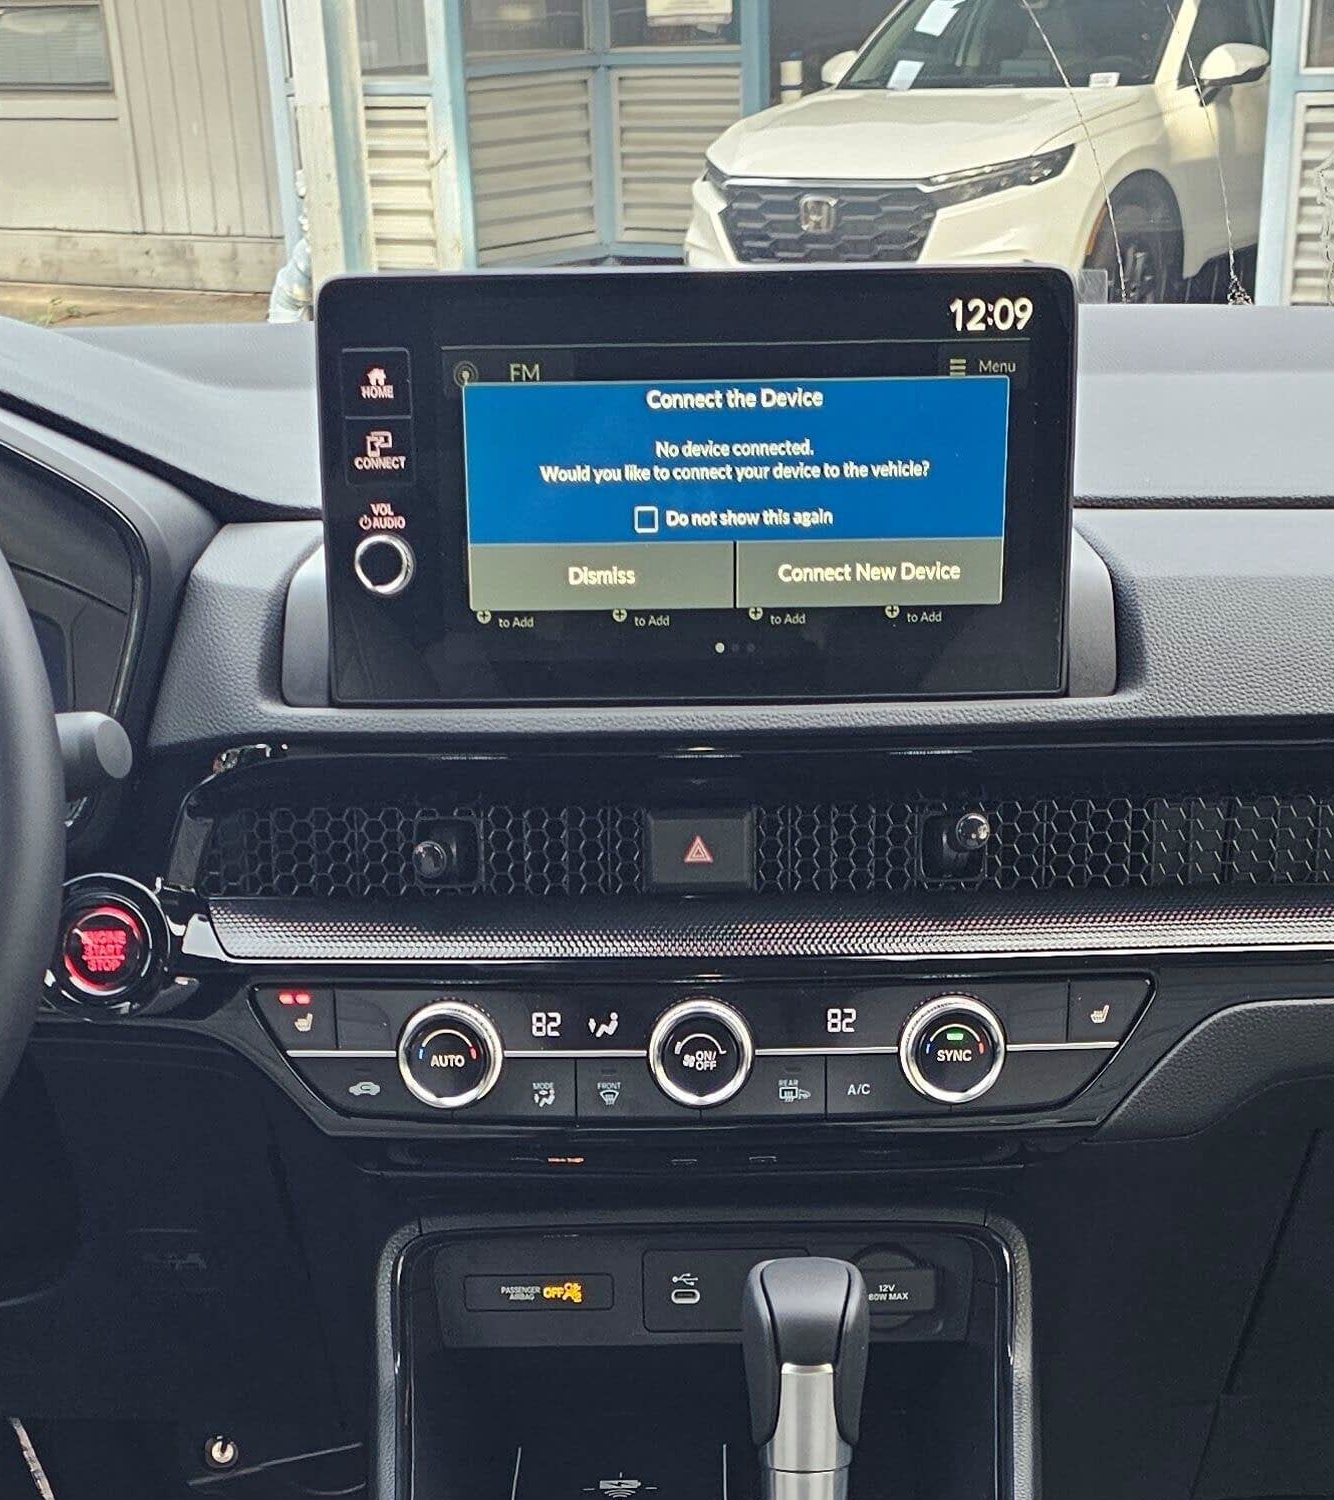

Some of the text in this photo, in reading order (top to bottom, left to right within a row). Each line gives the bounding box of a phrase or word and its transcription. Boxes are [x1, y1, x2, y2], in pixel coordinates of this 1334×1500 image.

[949, 297, 1034, 332] 12:09
[509, 363, 541, 382] FM
[978, 359, 1017, 373] Menu
[360, 385, 395, 399] HOME
[646, 387, 823, 409] Connect the Device
[655, 439, 815, 458] No device connected.
[353, 456, 407, 470] CONNECT
[539, 460, 931, 484] Would you like to connect your device to the vehicle?
[370, 503, 395, 516] VOL
[373, 516, 407, 529] AUDIO
[665, 508, 834, 527] Do not show this again
[568, 566, 636, 585] Dismiss
[778, 560, 961, 583] Connect New Device
[498, 616, 535, 629] to Add
[634, 615, 670, 627] to Add
[770, 613, 806, 625] to Add
[906, 611, 942, 623] to Add
[82, 945, 124, 956] START
[87, 959, 122, 972] STOP
[531, 1012, 562, 1037] 82
[827, 1008, 857, 1033] 82
[430, 1054, 466, 1068] AUTO
[695, 1050, 717, 1061] ON/
[936, 1048, 972, 1063] SYNC
[695, 1060, 717, 1071] OFF
[532, 1082, 554, 1090] MODE
[597, 1082, 621, 1090] FRONT
[778, 1079, 799, 1087] REAR
[847, 1083, 871, 1096] A/C
[500, 1286, 541, 1294] PASSENGER
[543, 1286, 564, 1299] OFF
[879, 1284, 896, 1293] 12V
[888, 1292, 909, 1300] MAX
